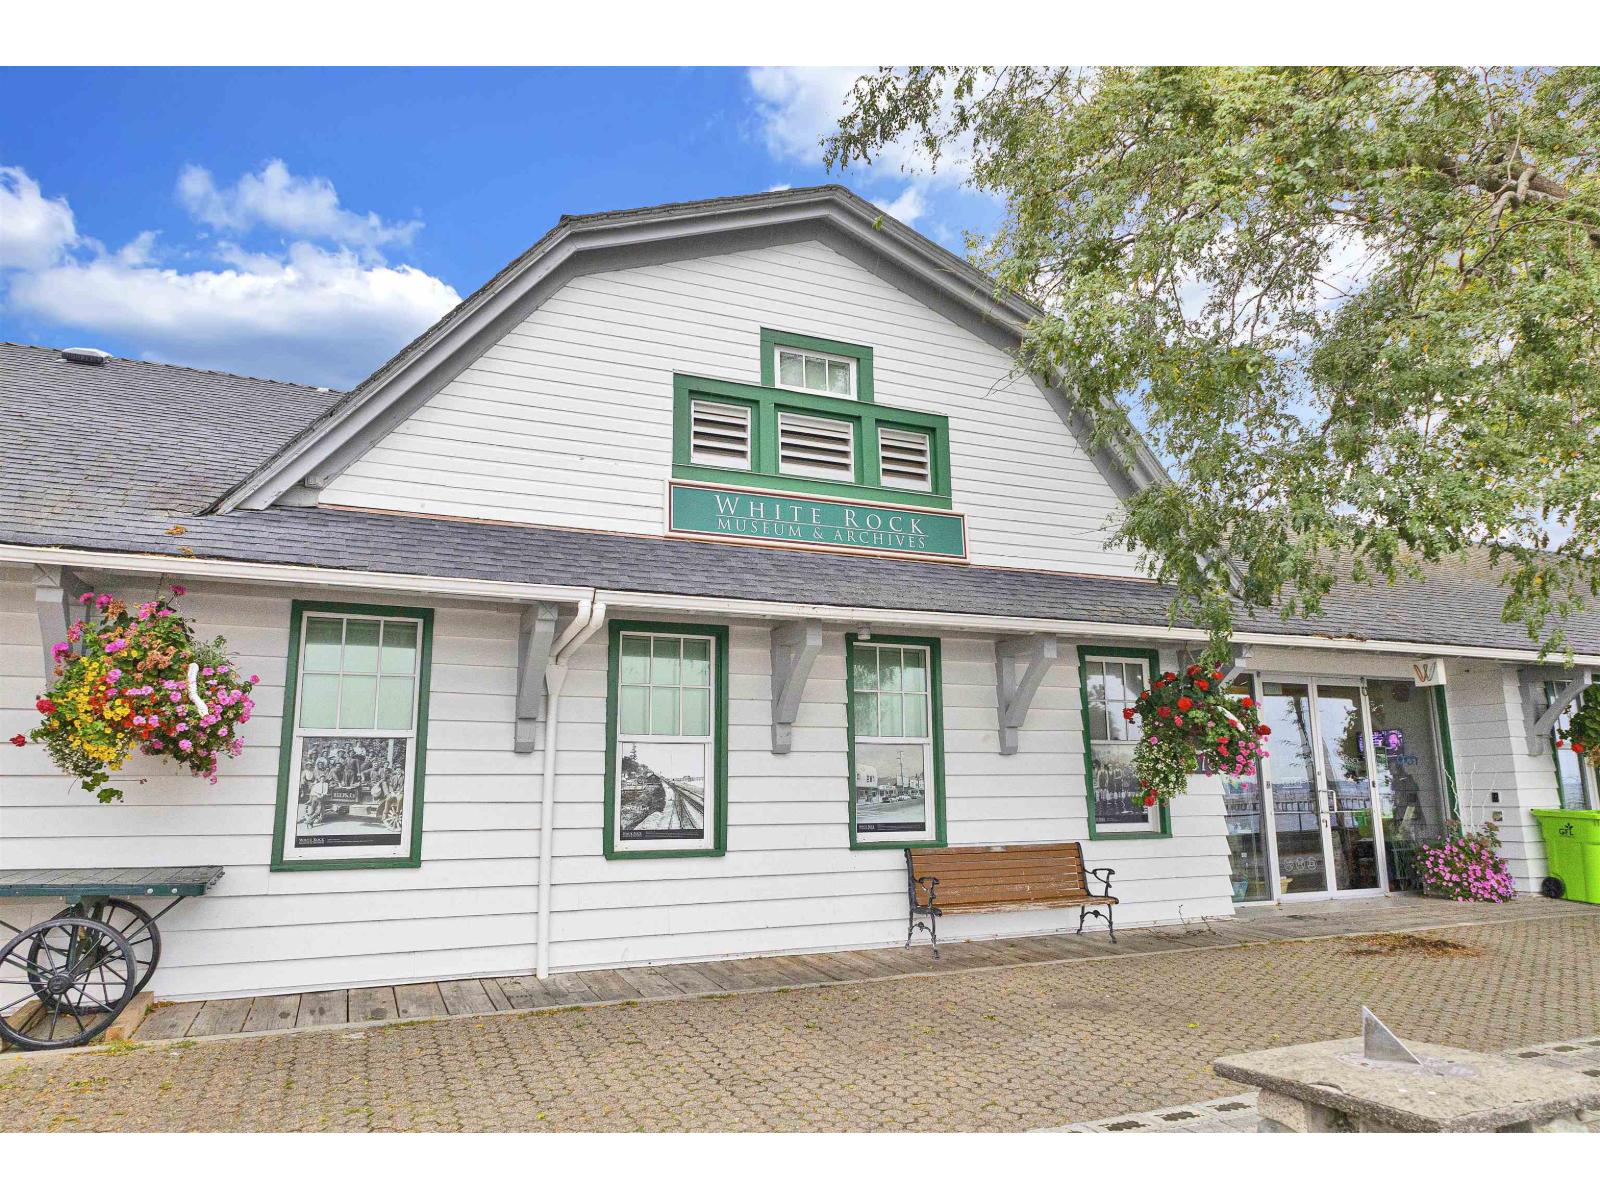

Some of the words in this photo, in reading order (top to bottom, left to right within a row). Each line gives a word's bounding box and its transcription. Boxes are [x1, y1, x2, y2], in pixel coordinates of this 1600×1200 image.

[714, 495, 821, 525] WHITE
[844, 508, 925, 535] ROCK
[718, 518, 803, 537] MUSEUM
[813, 526, 825, 540] &
[834, 529, 925, 549] ARCHIVES
